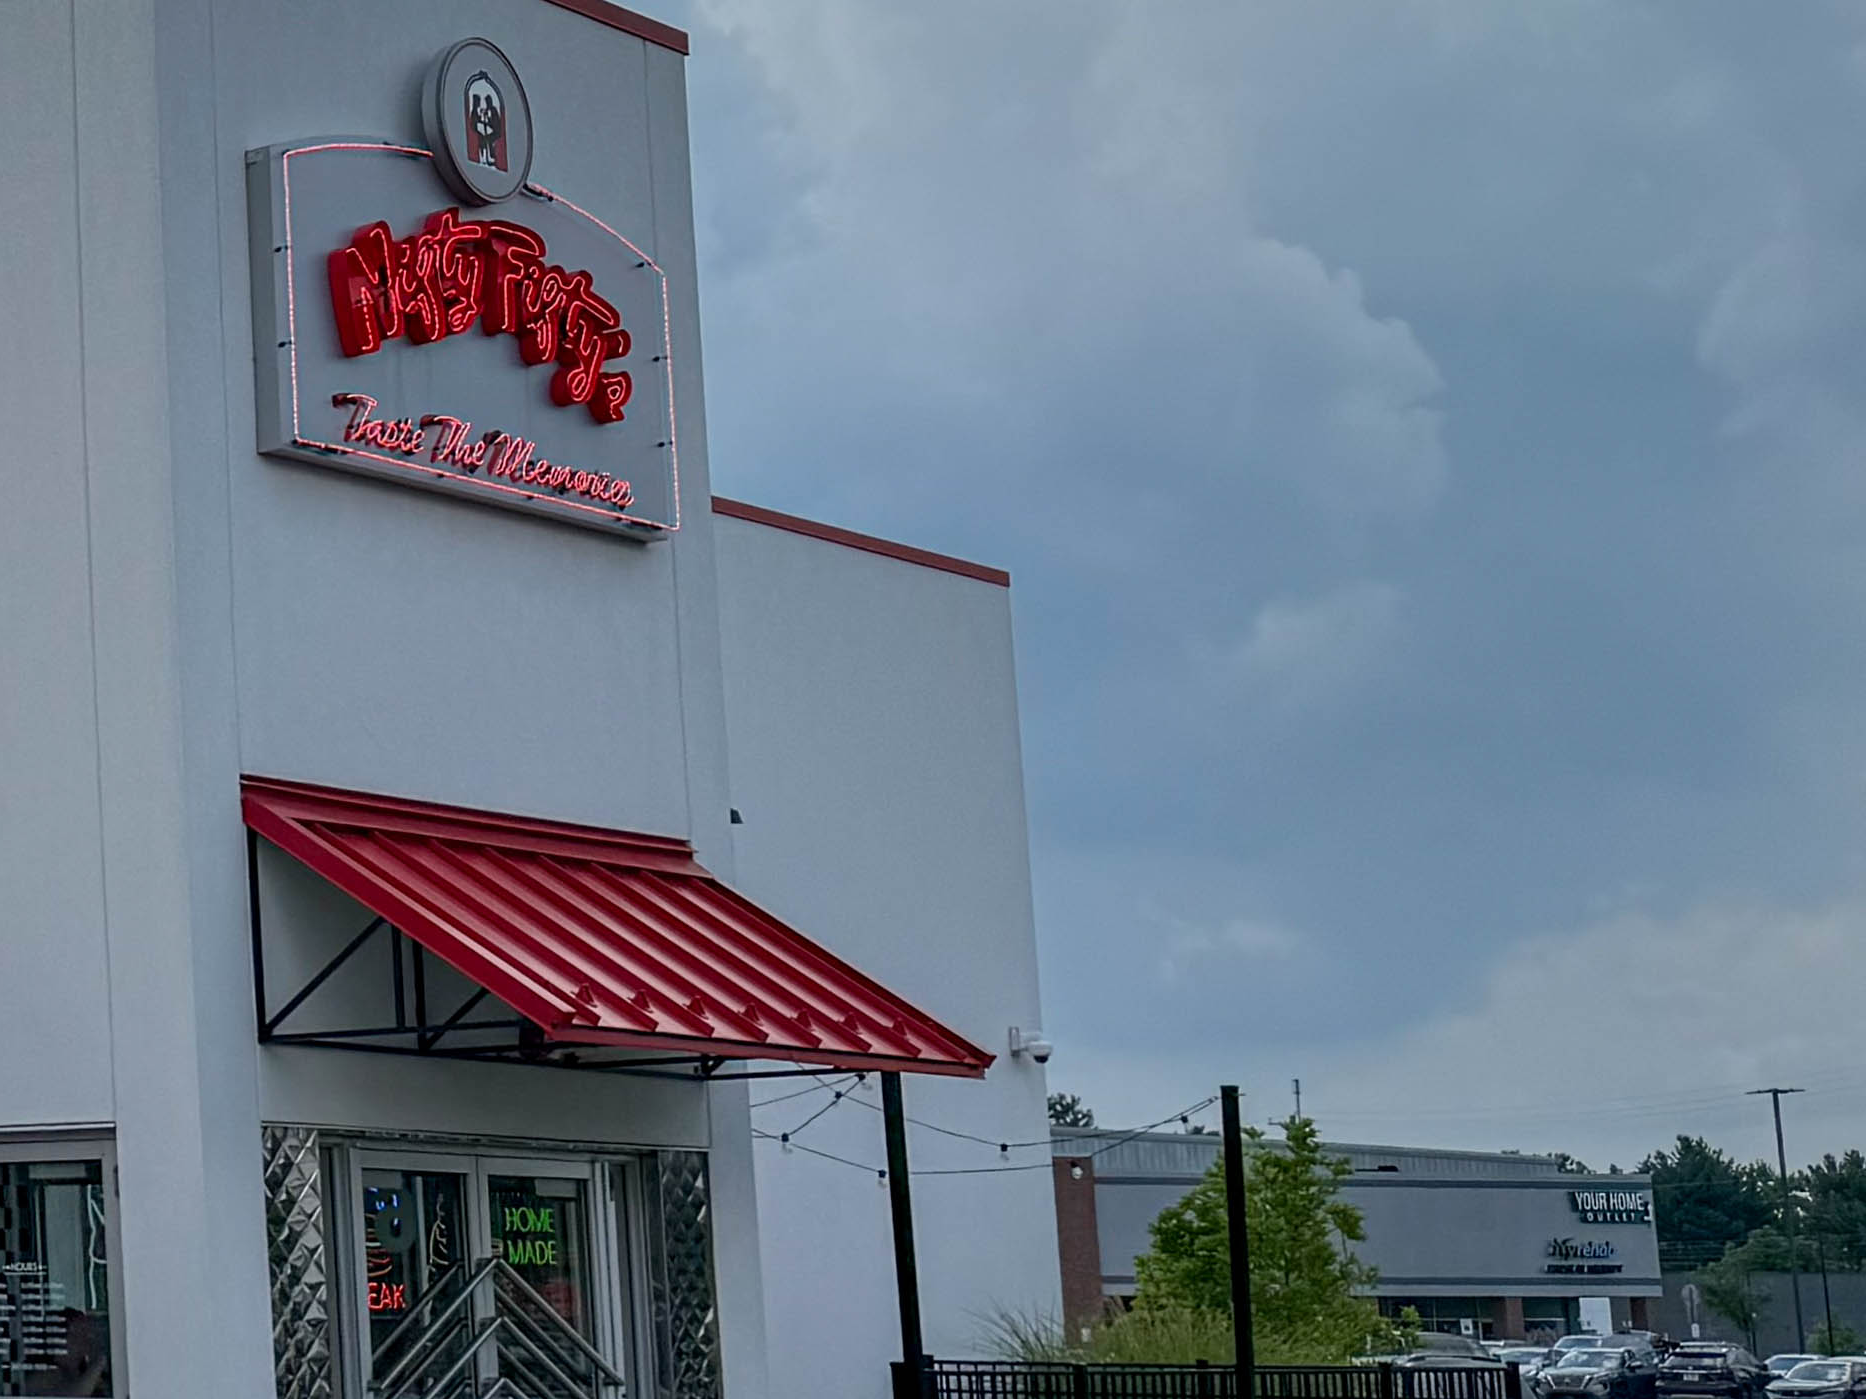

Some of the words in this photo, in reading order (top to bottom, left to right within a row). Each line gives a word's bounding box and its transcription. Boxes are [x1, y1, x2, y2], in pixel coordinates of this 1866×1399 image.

[332, 393, 425, 456] Taste
[420, 414, 486, 470] The
[482, 429, 635, 509] Memories
[1574, 1191, 1607, 1211] YOUR
[1609, 1192, 1645, 1211] HOME
[504, 1206, 555, 1233] HOME
[506, 1239, 557, 1265] MADE
[368, 1281, 407, 1312] EAK
